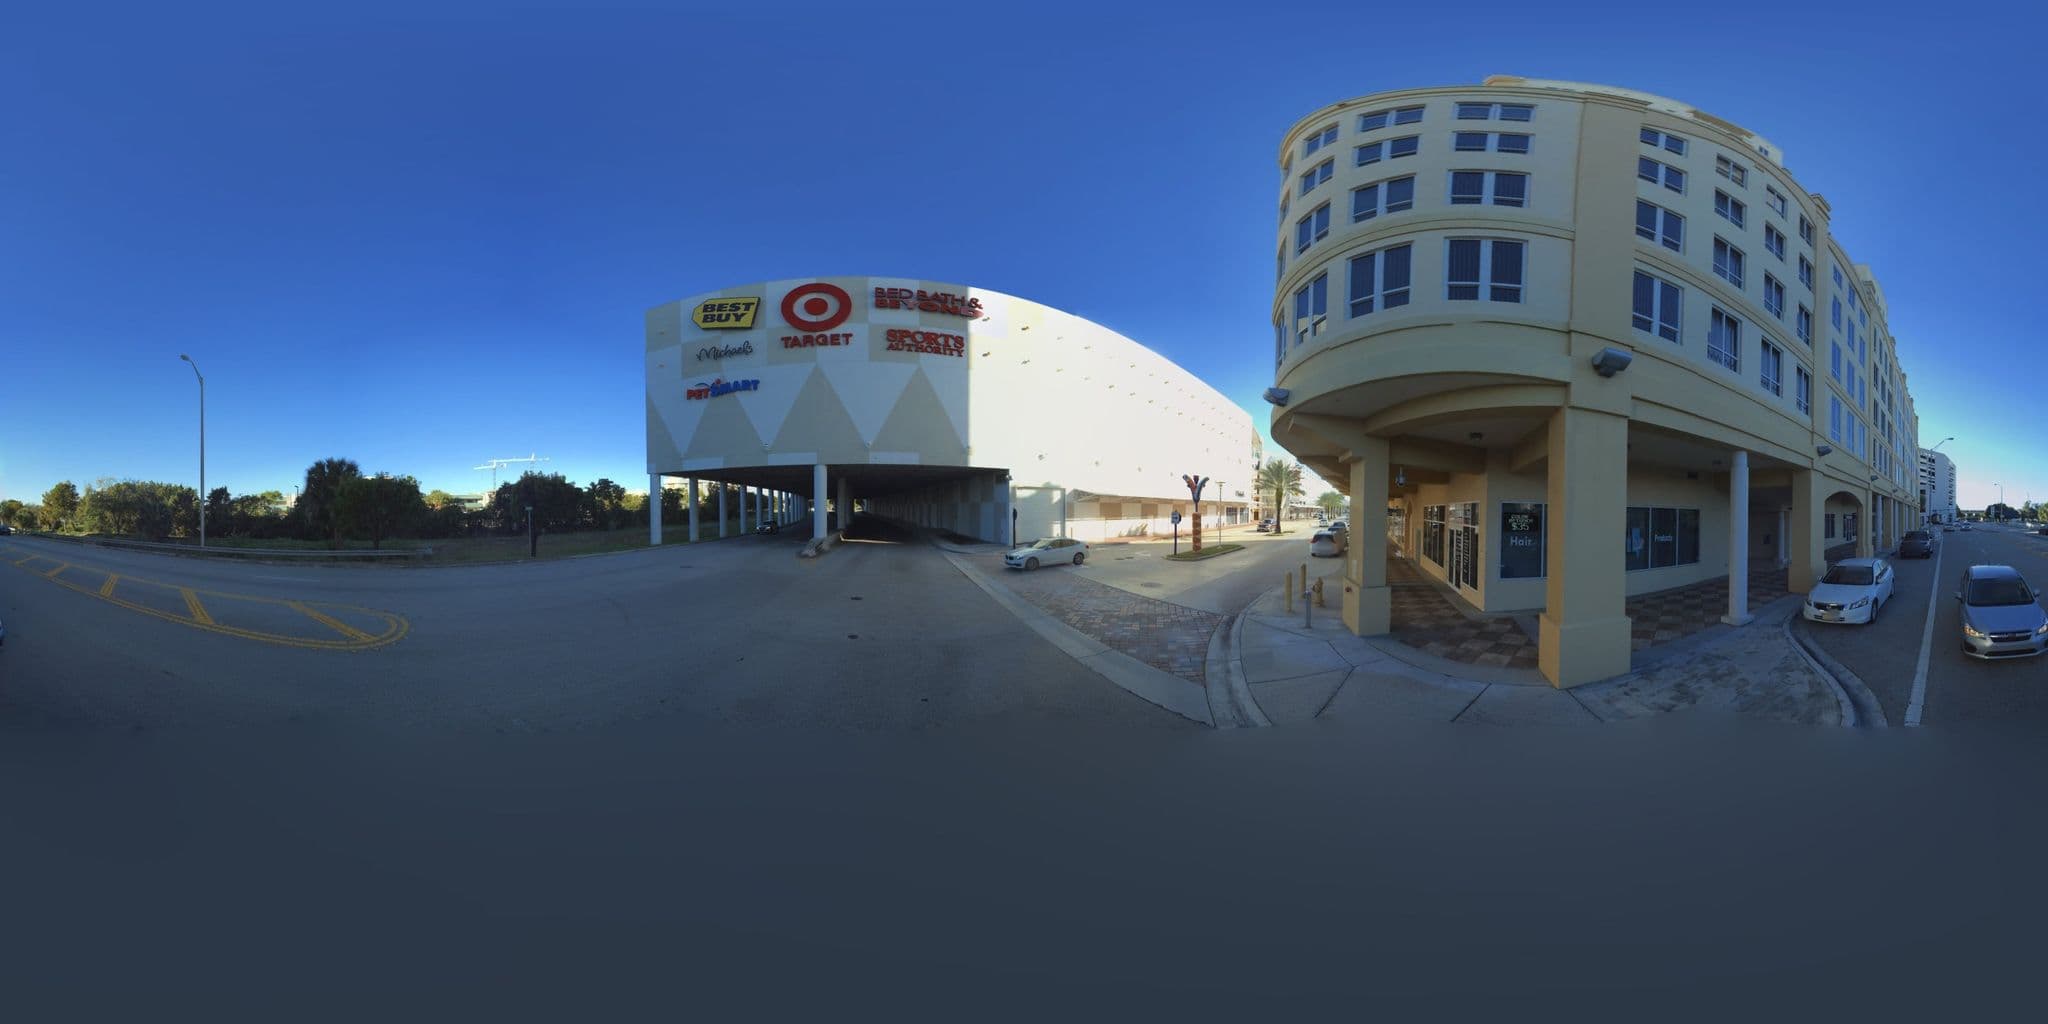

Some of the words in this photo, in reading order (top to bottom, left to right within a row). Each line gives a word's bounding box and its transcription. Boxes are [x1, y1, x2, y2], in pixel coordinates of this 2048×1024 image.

[875, 287, 914, 299] BED
[917, 290, 966, 305] BATH
[968, 297, 984, 310] &
[702, 302, 755, 313] BEST
[875, 299, 985, 318] BEYOND
[702, 313, 747, 323] BUY
[781, 333, 854, 349] TARGET
[886, 329, 965, 349] SPORTS
[696, 340, 753, 361] Michaels
[886, 341, 965, 357] AUTHORITY
[1510, 536, 1532, 546] Hair
